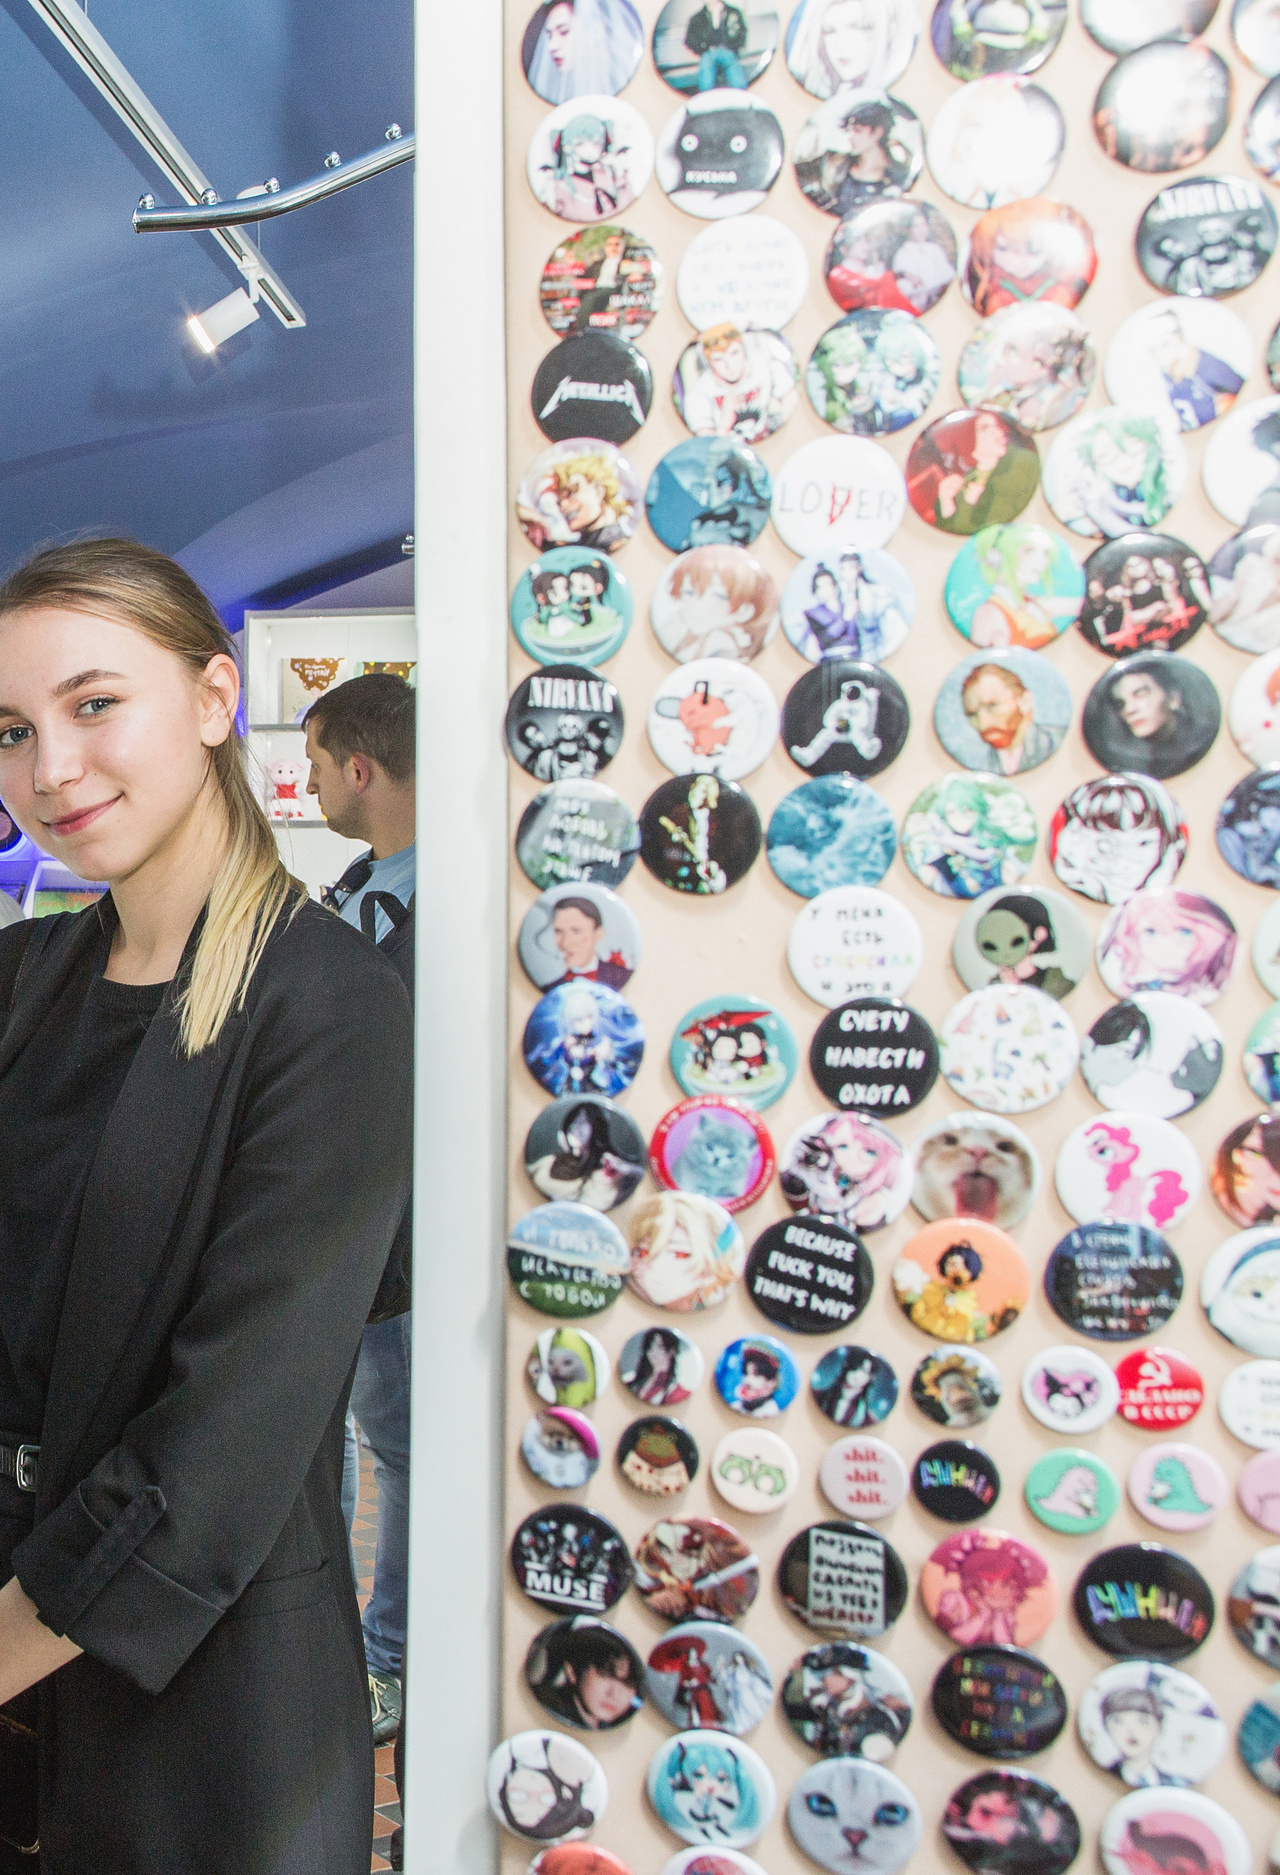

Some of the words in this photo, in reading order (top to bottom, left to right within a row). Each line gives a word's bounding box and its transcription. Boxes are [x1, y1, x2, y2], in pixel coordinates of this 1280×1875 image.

[539, 375, 645, 425] METALLICA
[839, 1008, 911, 1033] СУЕТУ
[824, 1046, 927, 1070] НАВЕСТИ
[838, 1083, 912, 1106] ОХОТА
[784, 1224, 858, 1263] BECAUSE
[767, 1249, 815, 1281] FUCK
[753, 1275, 810, 1309] THAT'S
[810, 1292, 857, 1322] WHY
[1140, 1404, 1195, 1421] СССР
[525, 1569, 607, 1603] MUSE
[1085, 1580, 1210, 1643] ДУШНИЛА
